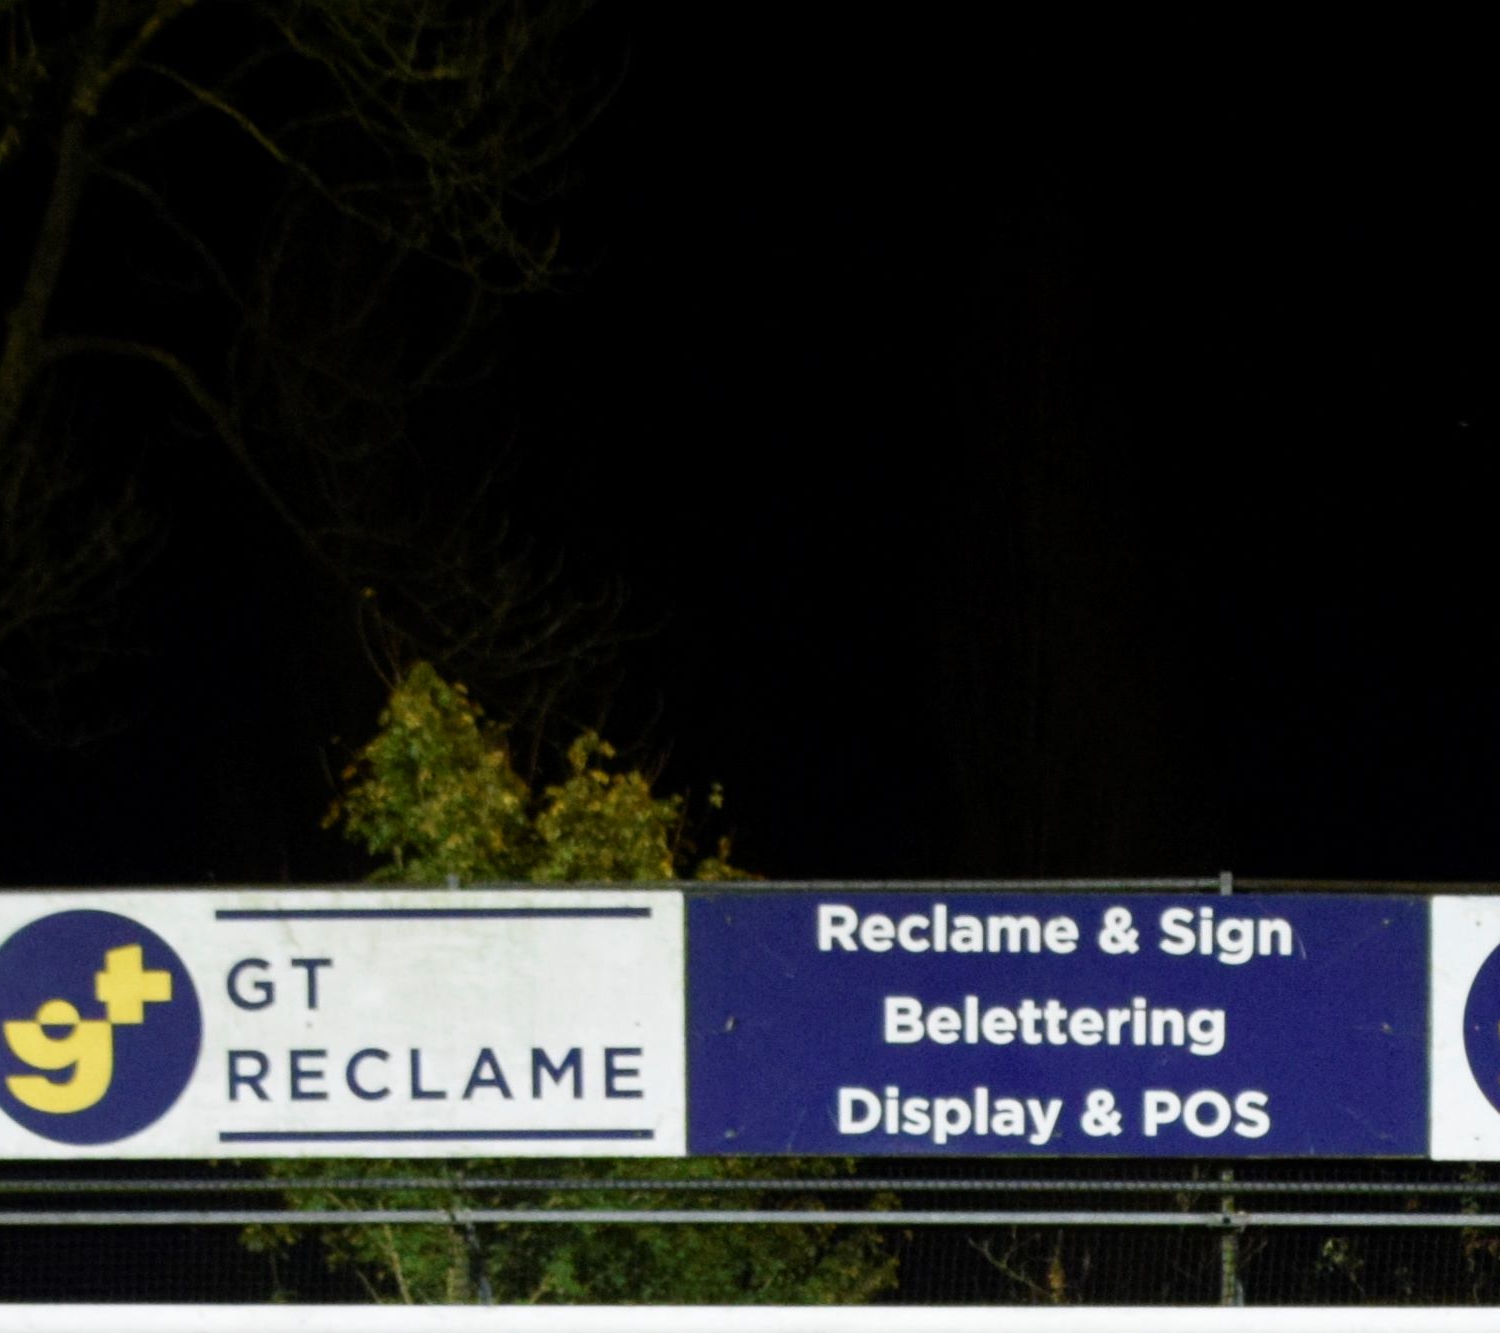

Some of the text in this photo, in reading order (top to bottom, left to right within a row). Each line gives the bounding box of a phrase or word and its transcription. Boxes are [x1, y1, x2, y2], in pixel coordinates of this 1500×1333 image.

[819, 905, 1291, 964] Reclame & Sign
[227, 959, 331, 1010] GT
[885, 996, 1224, 1055] Belettering
[229, 1048, 642, 1100] RECLAME
[839, 1087, 1269, 1144] Display & POS
